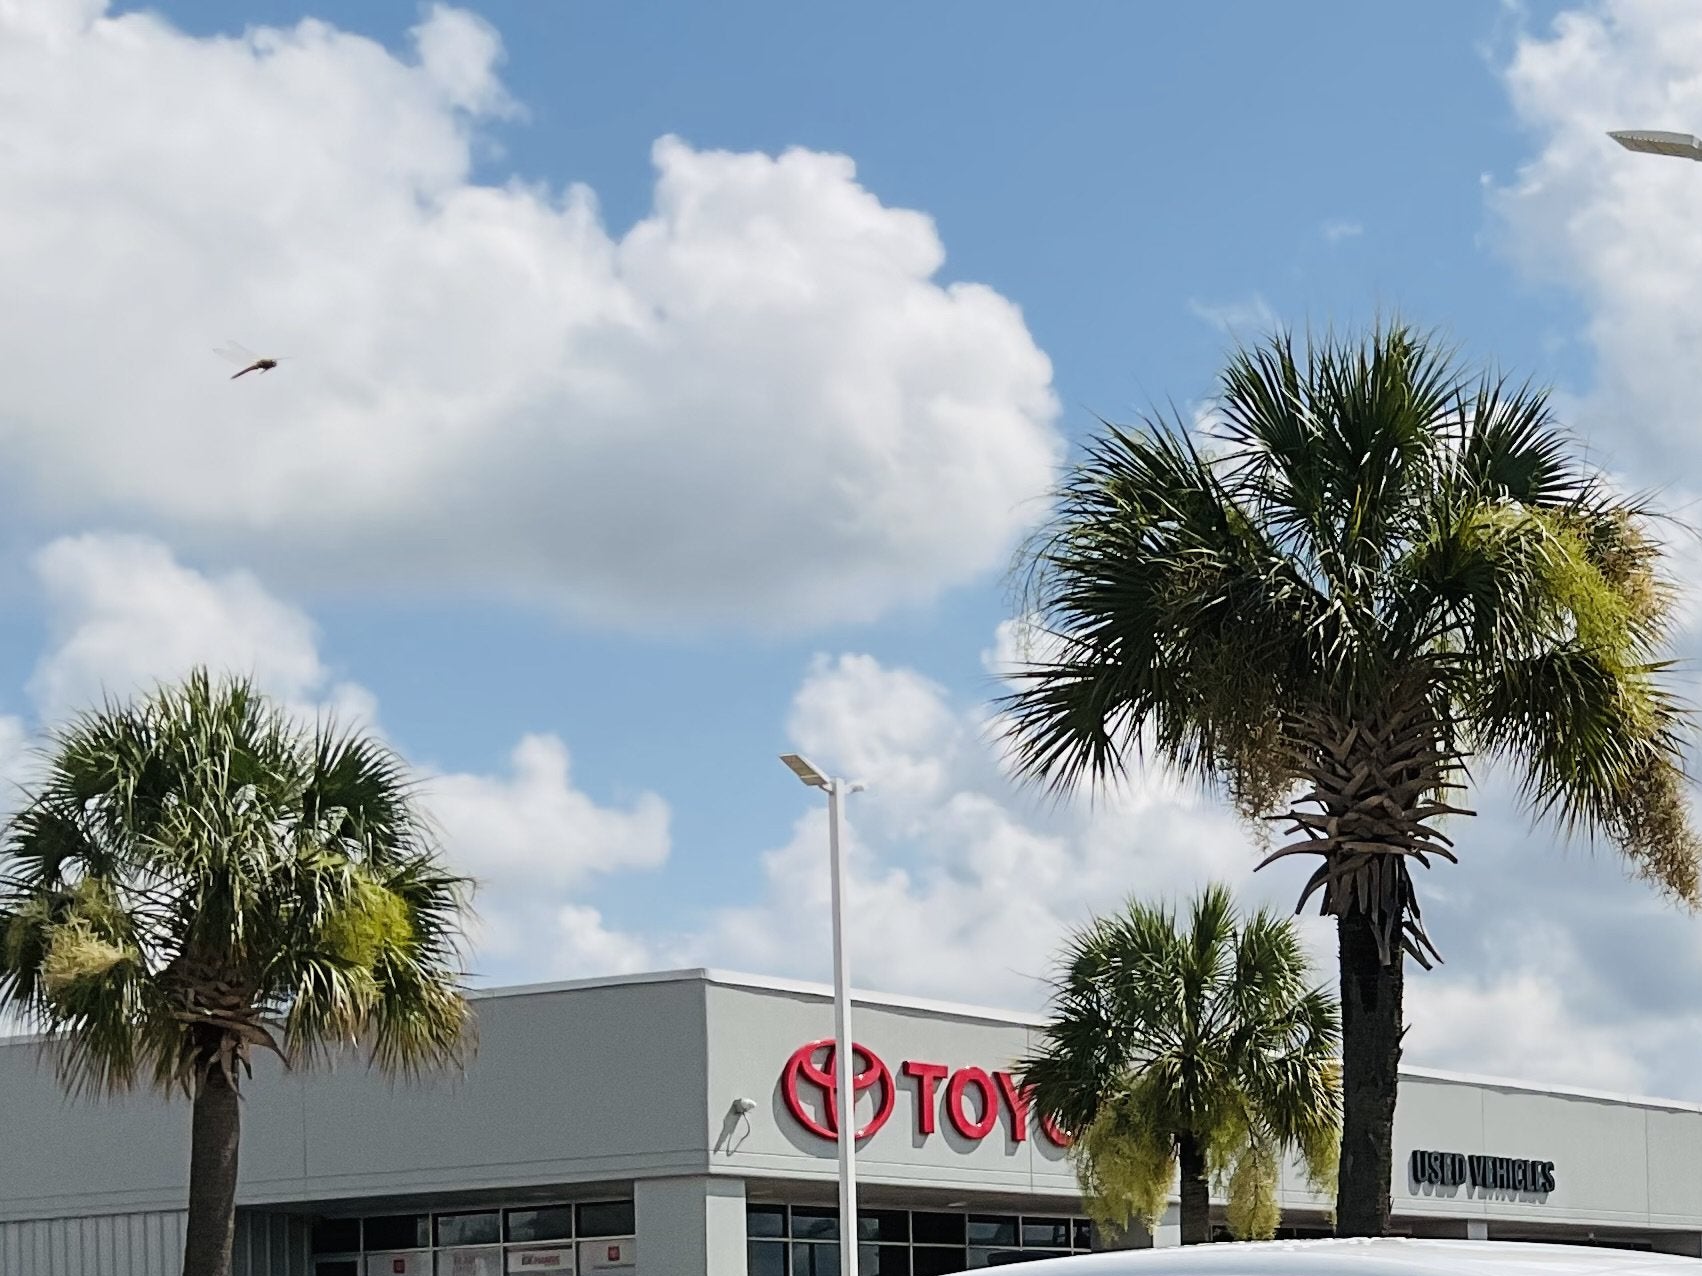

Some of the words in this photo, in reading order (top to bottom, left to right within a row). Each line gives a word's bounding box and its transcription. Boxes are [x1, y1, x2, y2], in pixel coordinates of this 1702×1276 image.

[902, 1060, 1074, 1147] TOY
[1411, 1150, 1467, 1186] USED
[1467, 1155, 1555, 1193] VEHICLES
